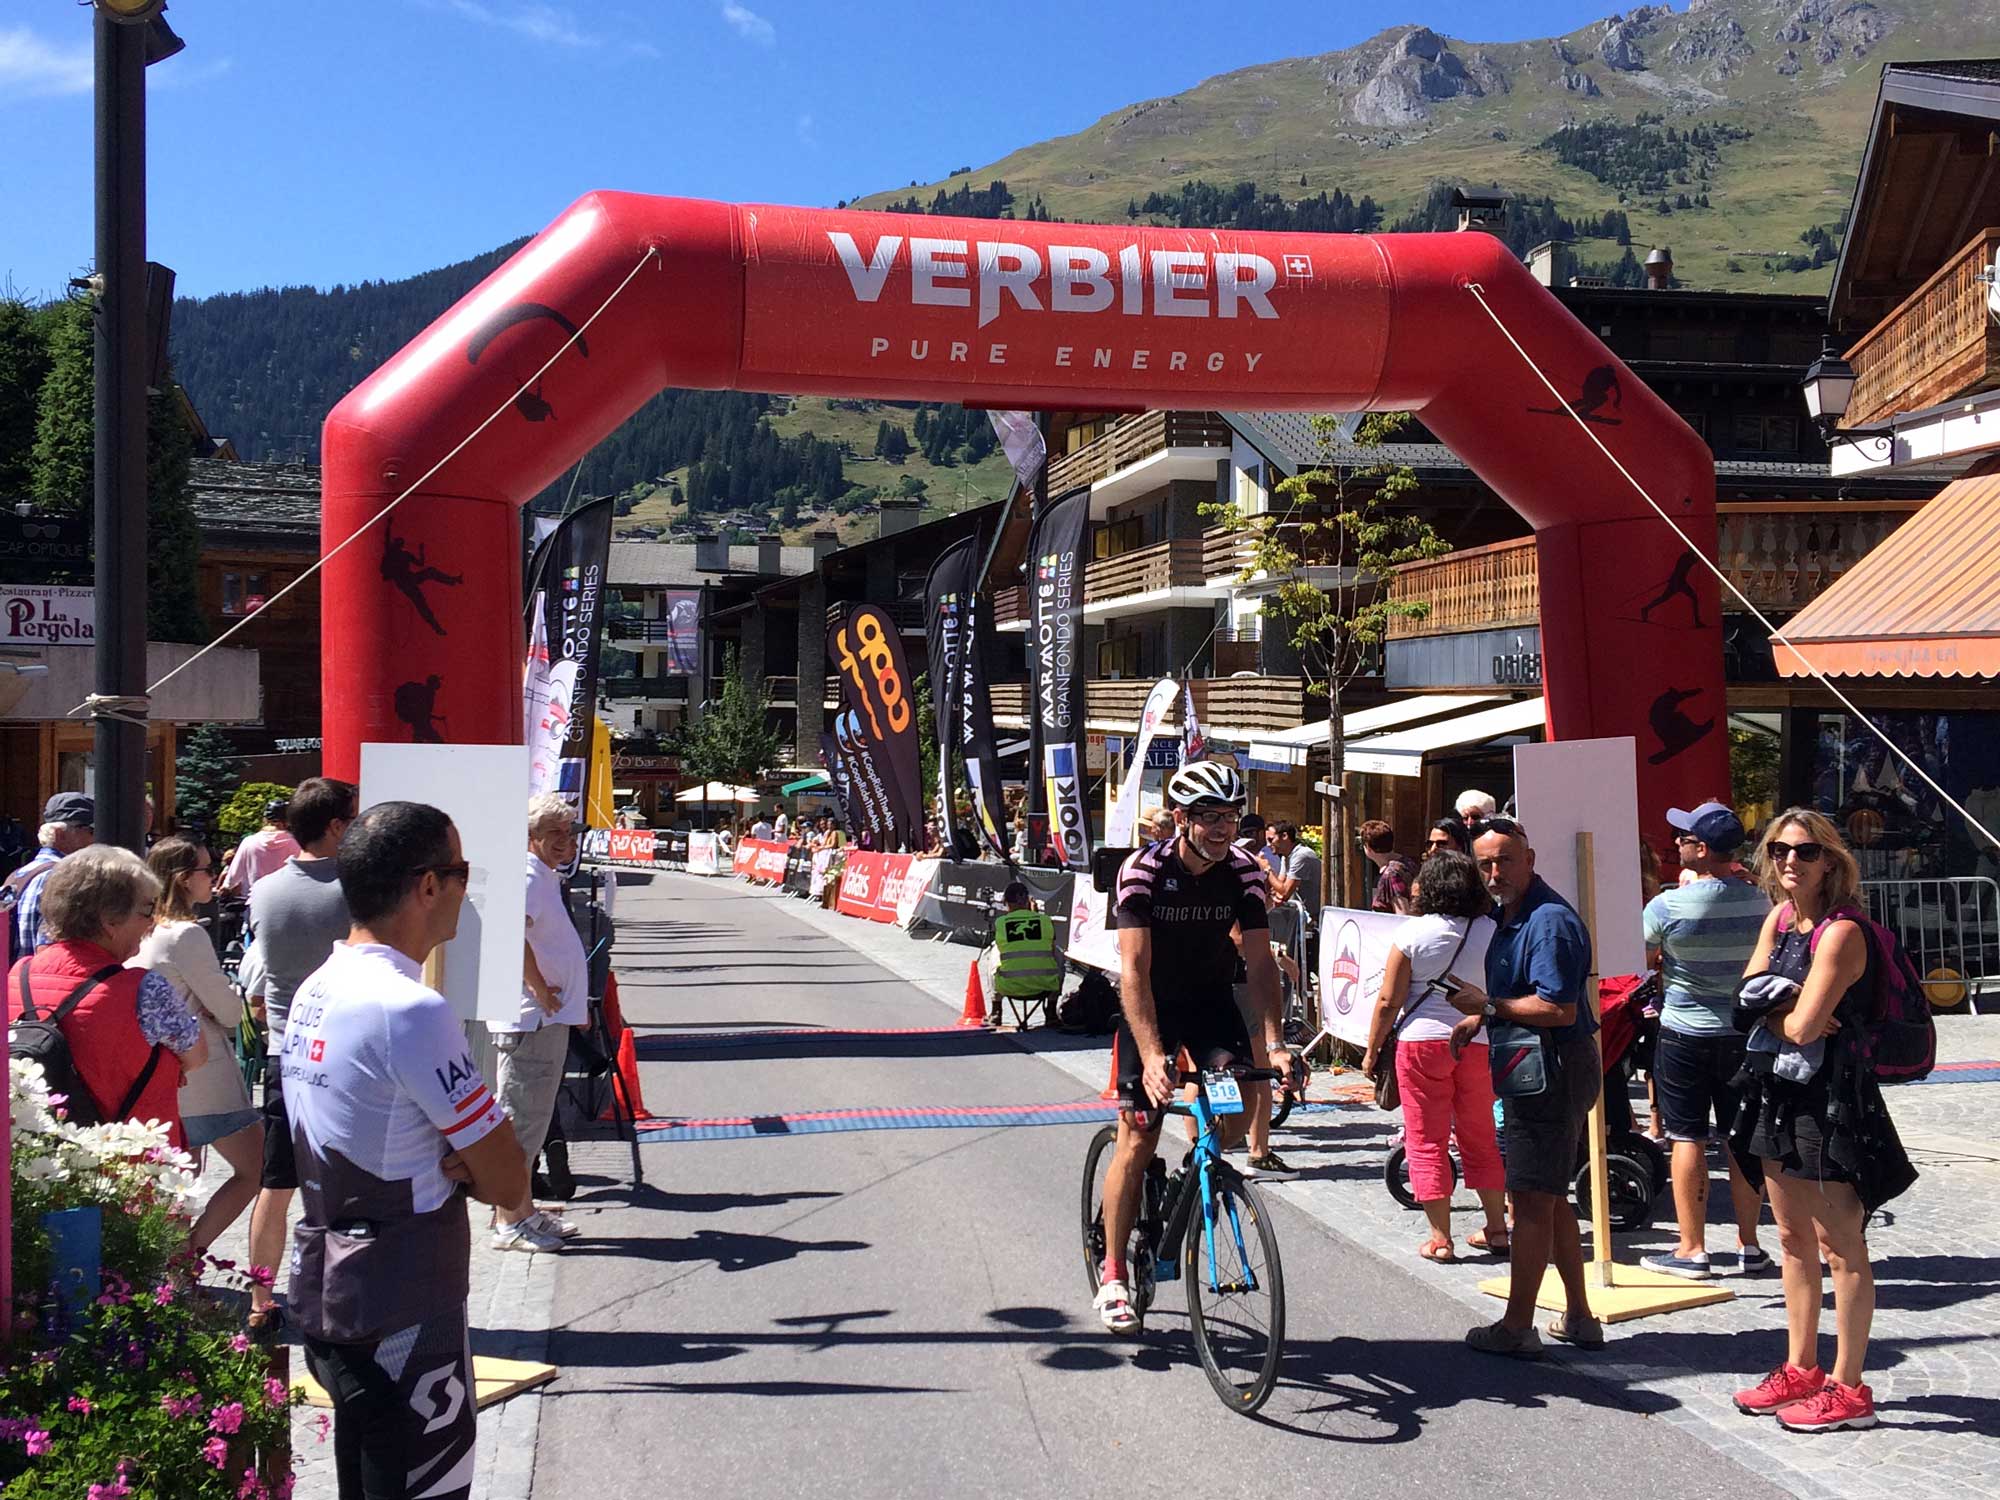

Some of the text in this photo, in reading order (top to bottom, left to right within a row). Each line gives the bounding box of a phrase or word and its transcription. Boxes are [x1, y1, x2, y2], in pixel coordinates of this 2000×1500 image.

[827, 231, 1280, 329] VERBIER
[871, 337, 1264, 373] PURE ENERGY
[6, 597, 94, 643] Pergola
[42, 599, 67, 622] La
[1057, 551, 1074, 729] GRANFONDO SERIES
[569, 564, 599, 743] GRANFONDO SERIES
[1038, 583, 1055, 729] MARMOTTE
[848, 756, 880, 834] #CoopRideTheAlps
[861, 751, 895, 832] #CoopRideTheAlps
[1057, 780, 1085, 862] LOOK
[292, 1003, 324, 1028] CLUB
[1210, 1085, 1238, 1098] 518
